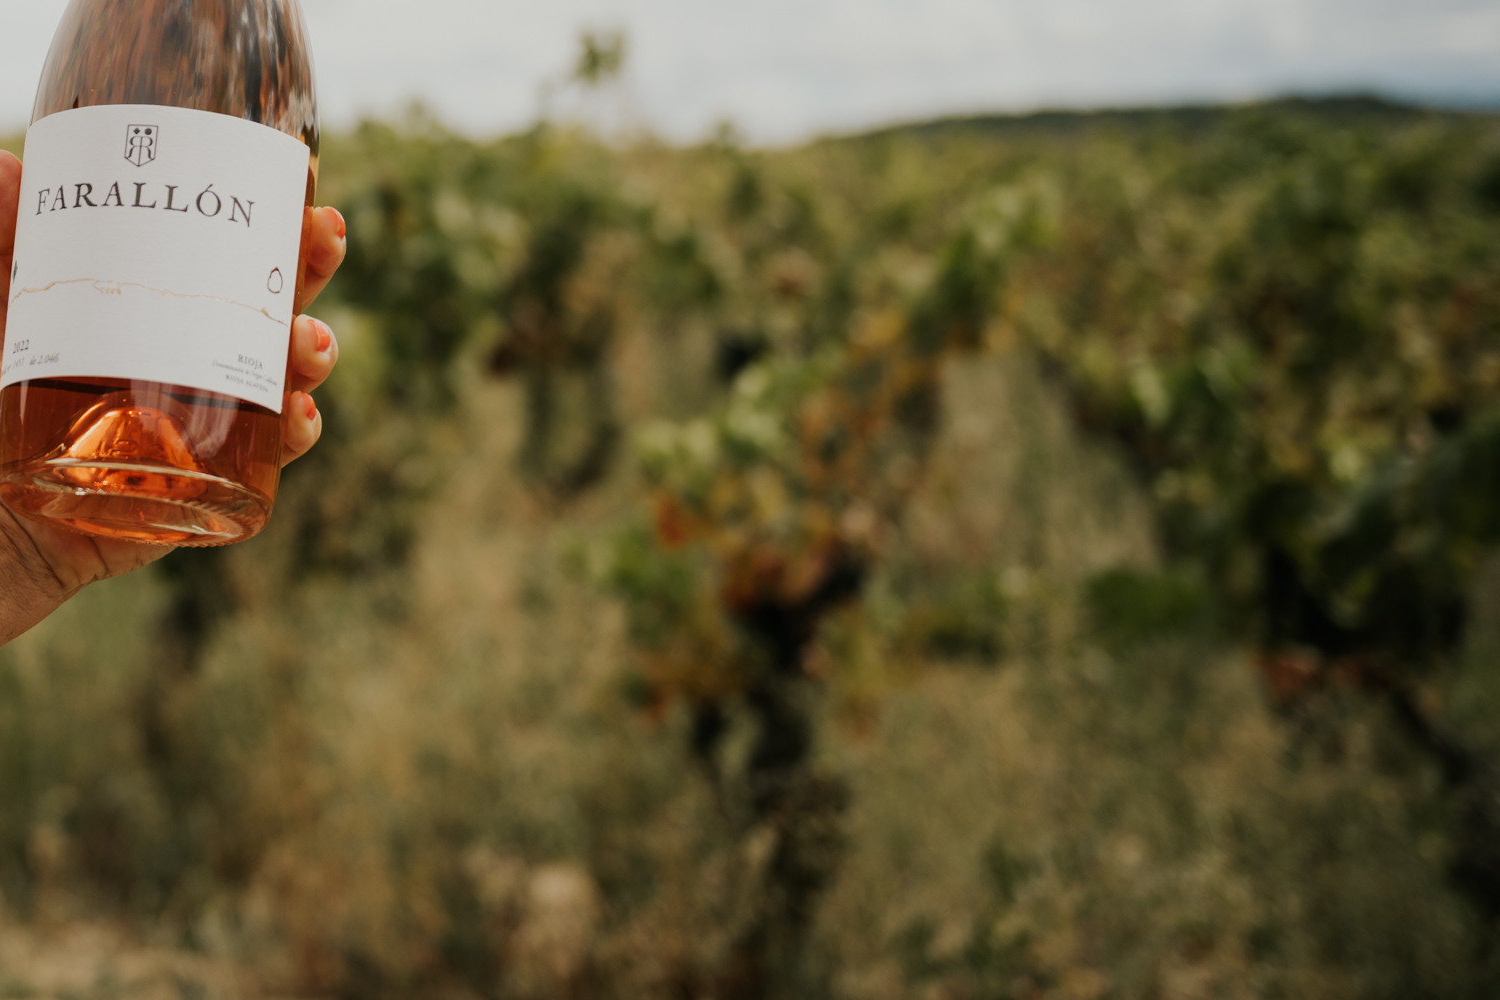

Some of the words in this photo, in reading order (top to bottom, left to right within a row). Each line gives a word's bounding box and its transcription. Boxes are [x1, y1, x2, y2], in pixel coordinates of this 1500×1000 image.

[35, 180, 255, 228] FARALLÓN
[12, 339, 30, 354] 2022
[237, 353, 263, 370] RIOJA
